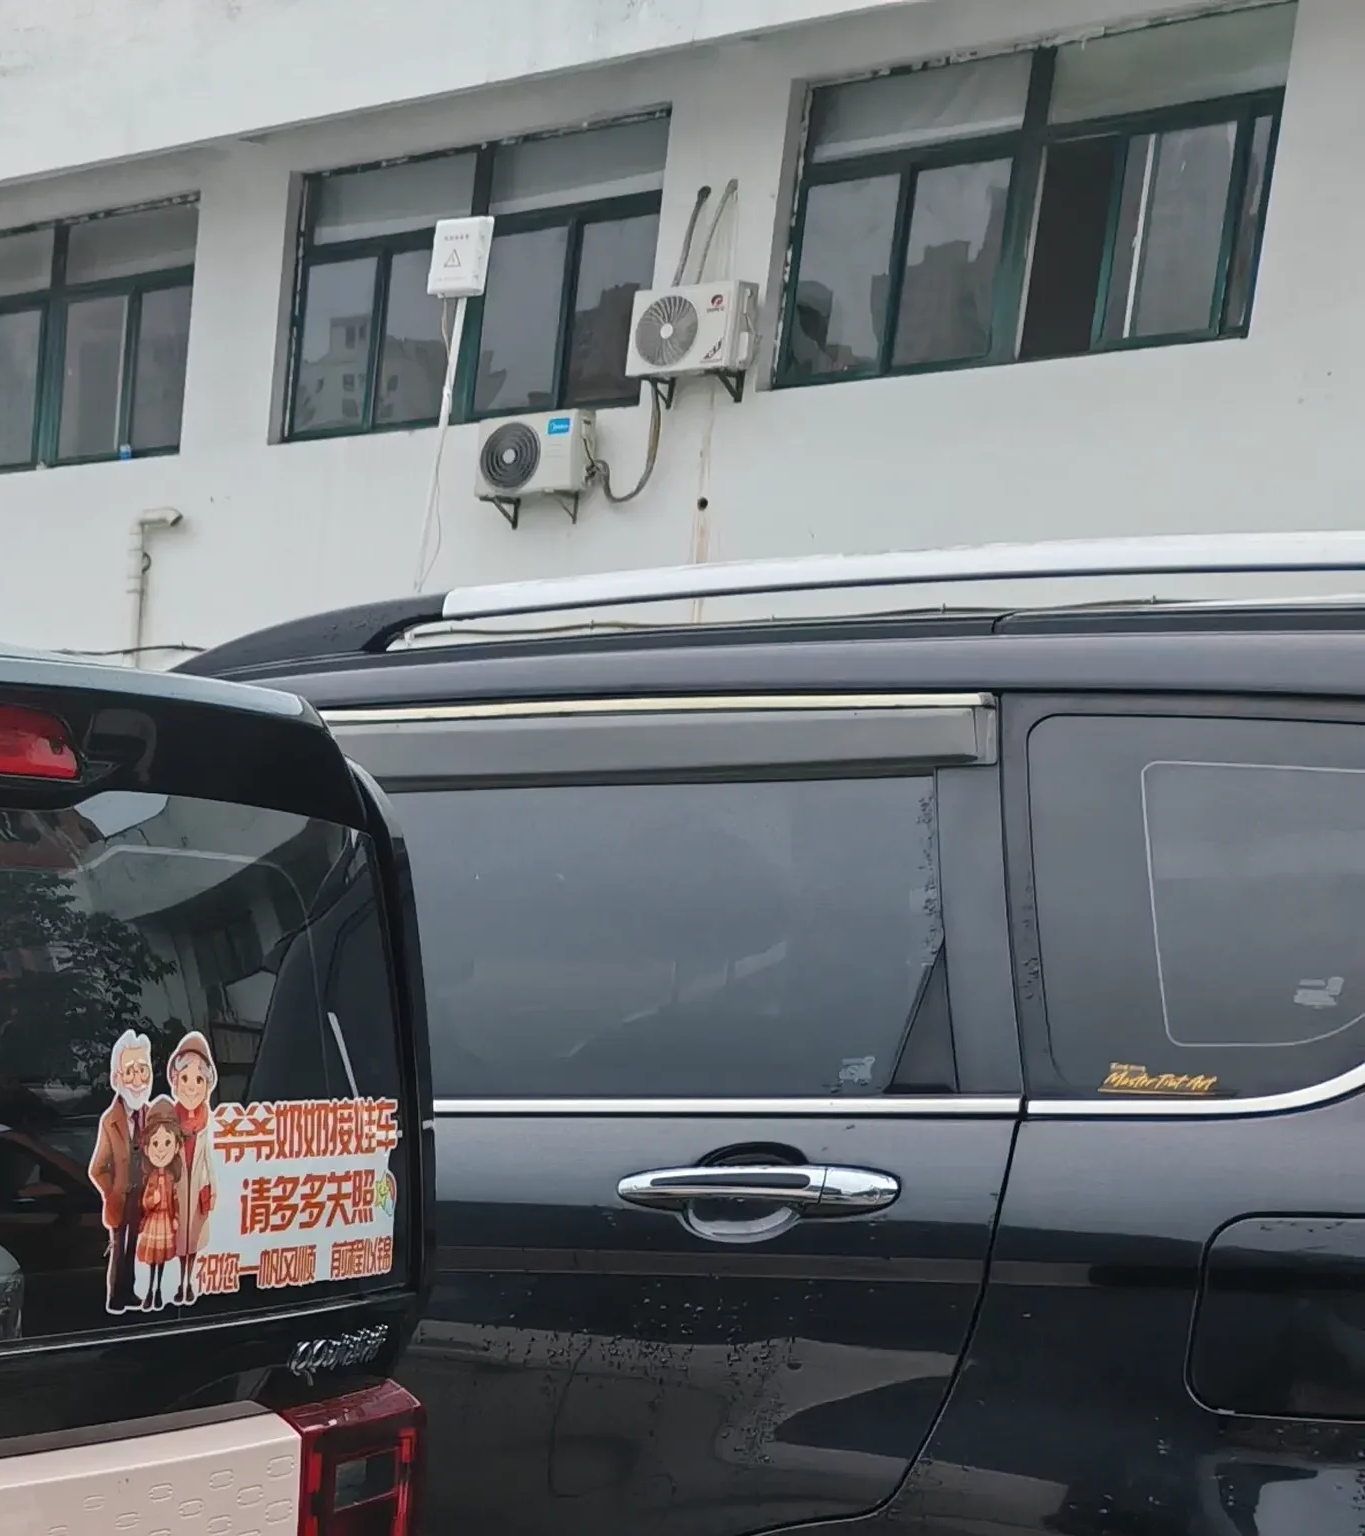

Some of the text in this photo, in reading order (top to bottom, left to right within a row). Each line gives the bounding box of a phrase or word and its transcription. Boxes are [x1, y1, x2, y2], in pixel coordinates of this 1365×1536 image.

[212, 1098, 398, 1163] 爷爷奶奶接娃车
[239, 1169, 375, 1235] 请多多关照
